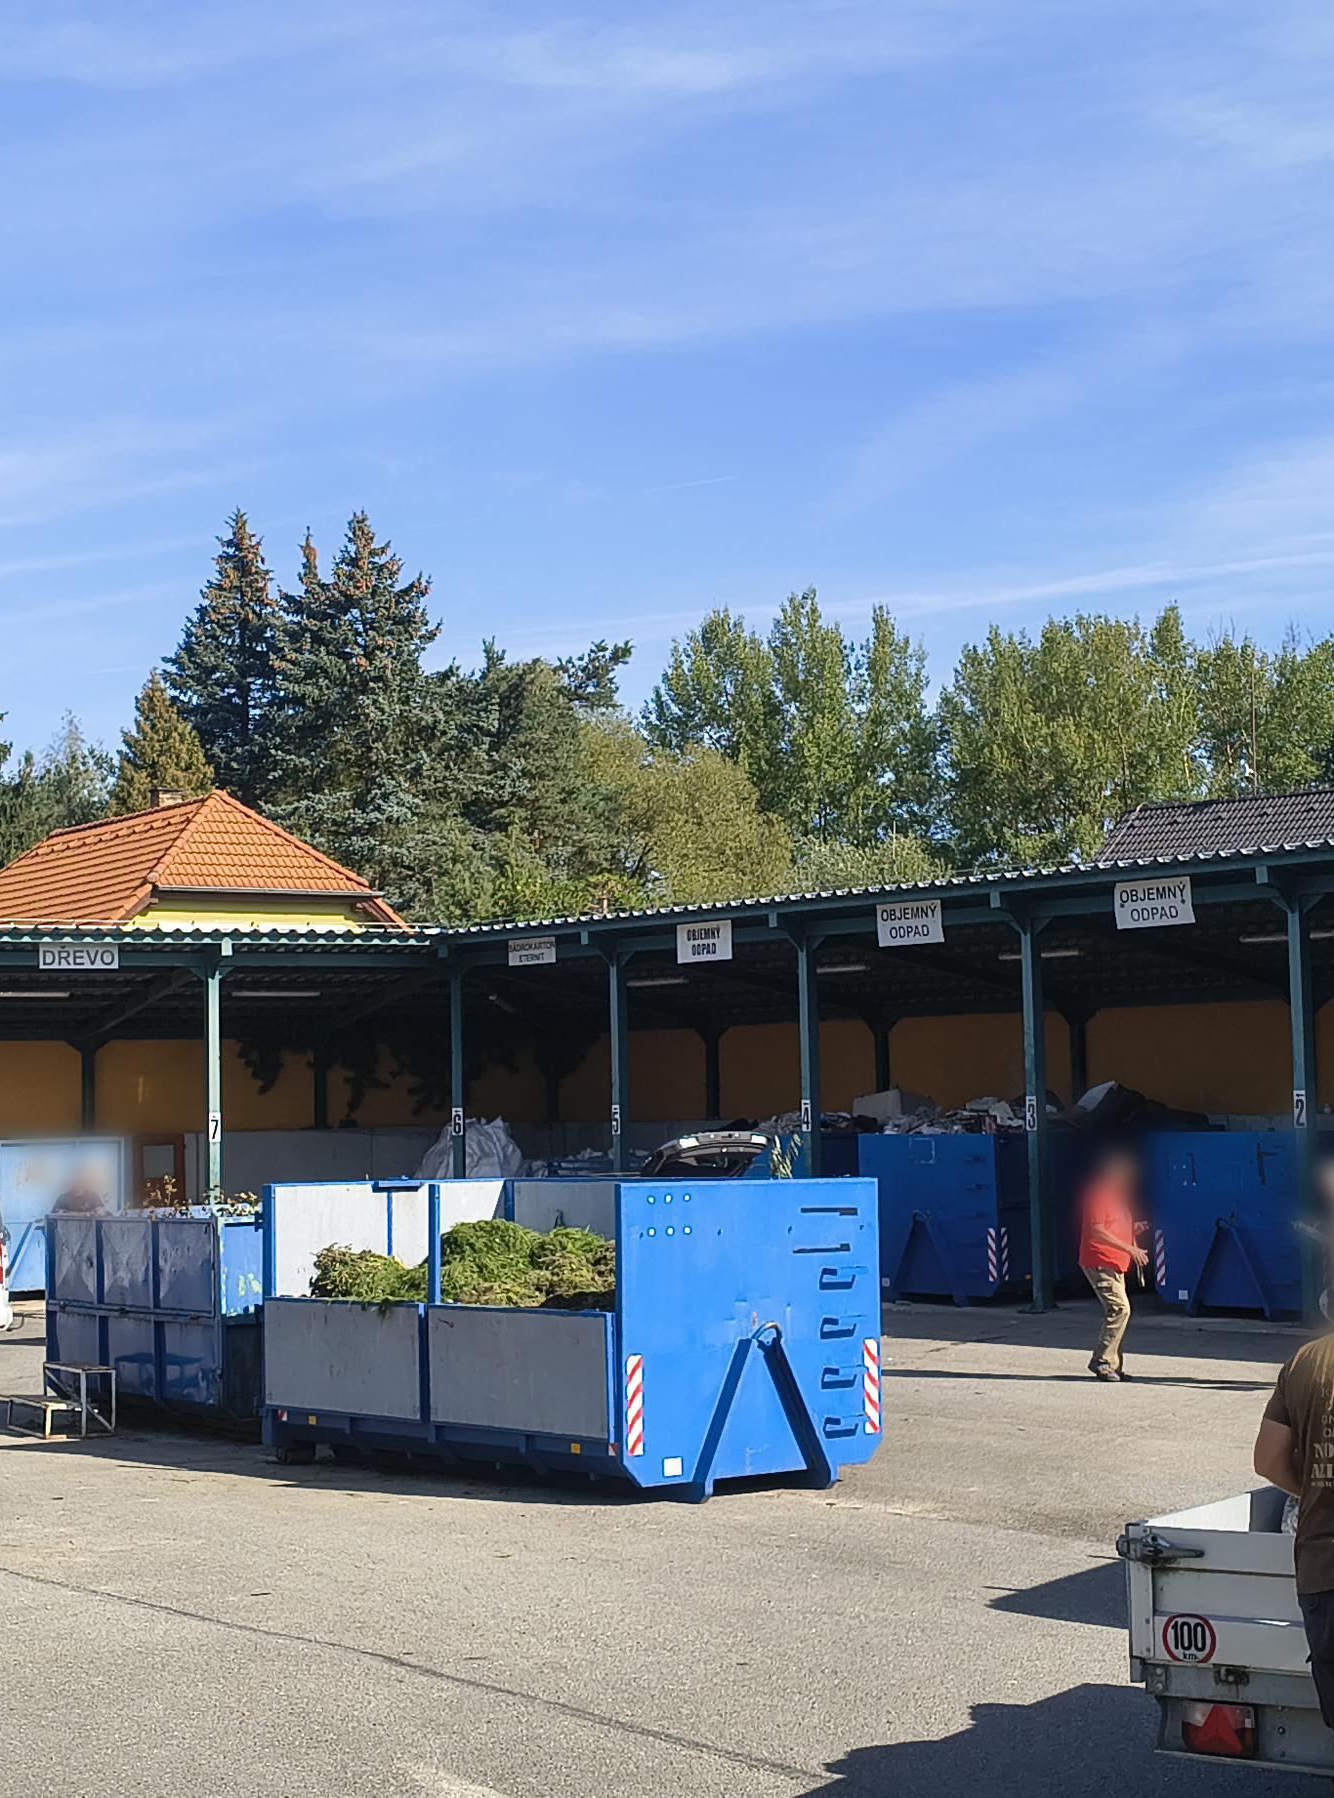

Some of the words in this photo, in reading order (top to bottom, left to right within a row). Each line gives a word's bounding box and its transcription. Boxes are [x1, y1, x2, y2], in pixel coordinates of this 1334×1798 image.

[1120, 881, 1186, 904] OBJEMNÝ
[880, 902, 937, 922] OBJEMNÝ
[1130, 905, 1179, 922] ODPAD
[889, 924, 929, 939] ODPAD
[42, 945, 115, 966] DŘEVO
[612, 1111, 619, 1133] 5
[802, 1106, 810, 1130] 4
[1027, 1103, 1036, 1129] 3
[1295, 1098, 1305, 1125] 2
[210, 1119, 219, 1140] 7
[454, 1113, 462, 1135] 6
[1313, 1442, 1334, 1458] NO
[1171, 1620, 1207, 1652] 100
